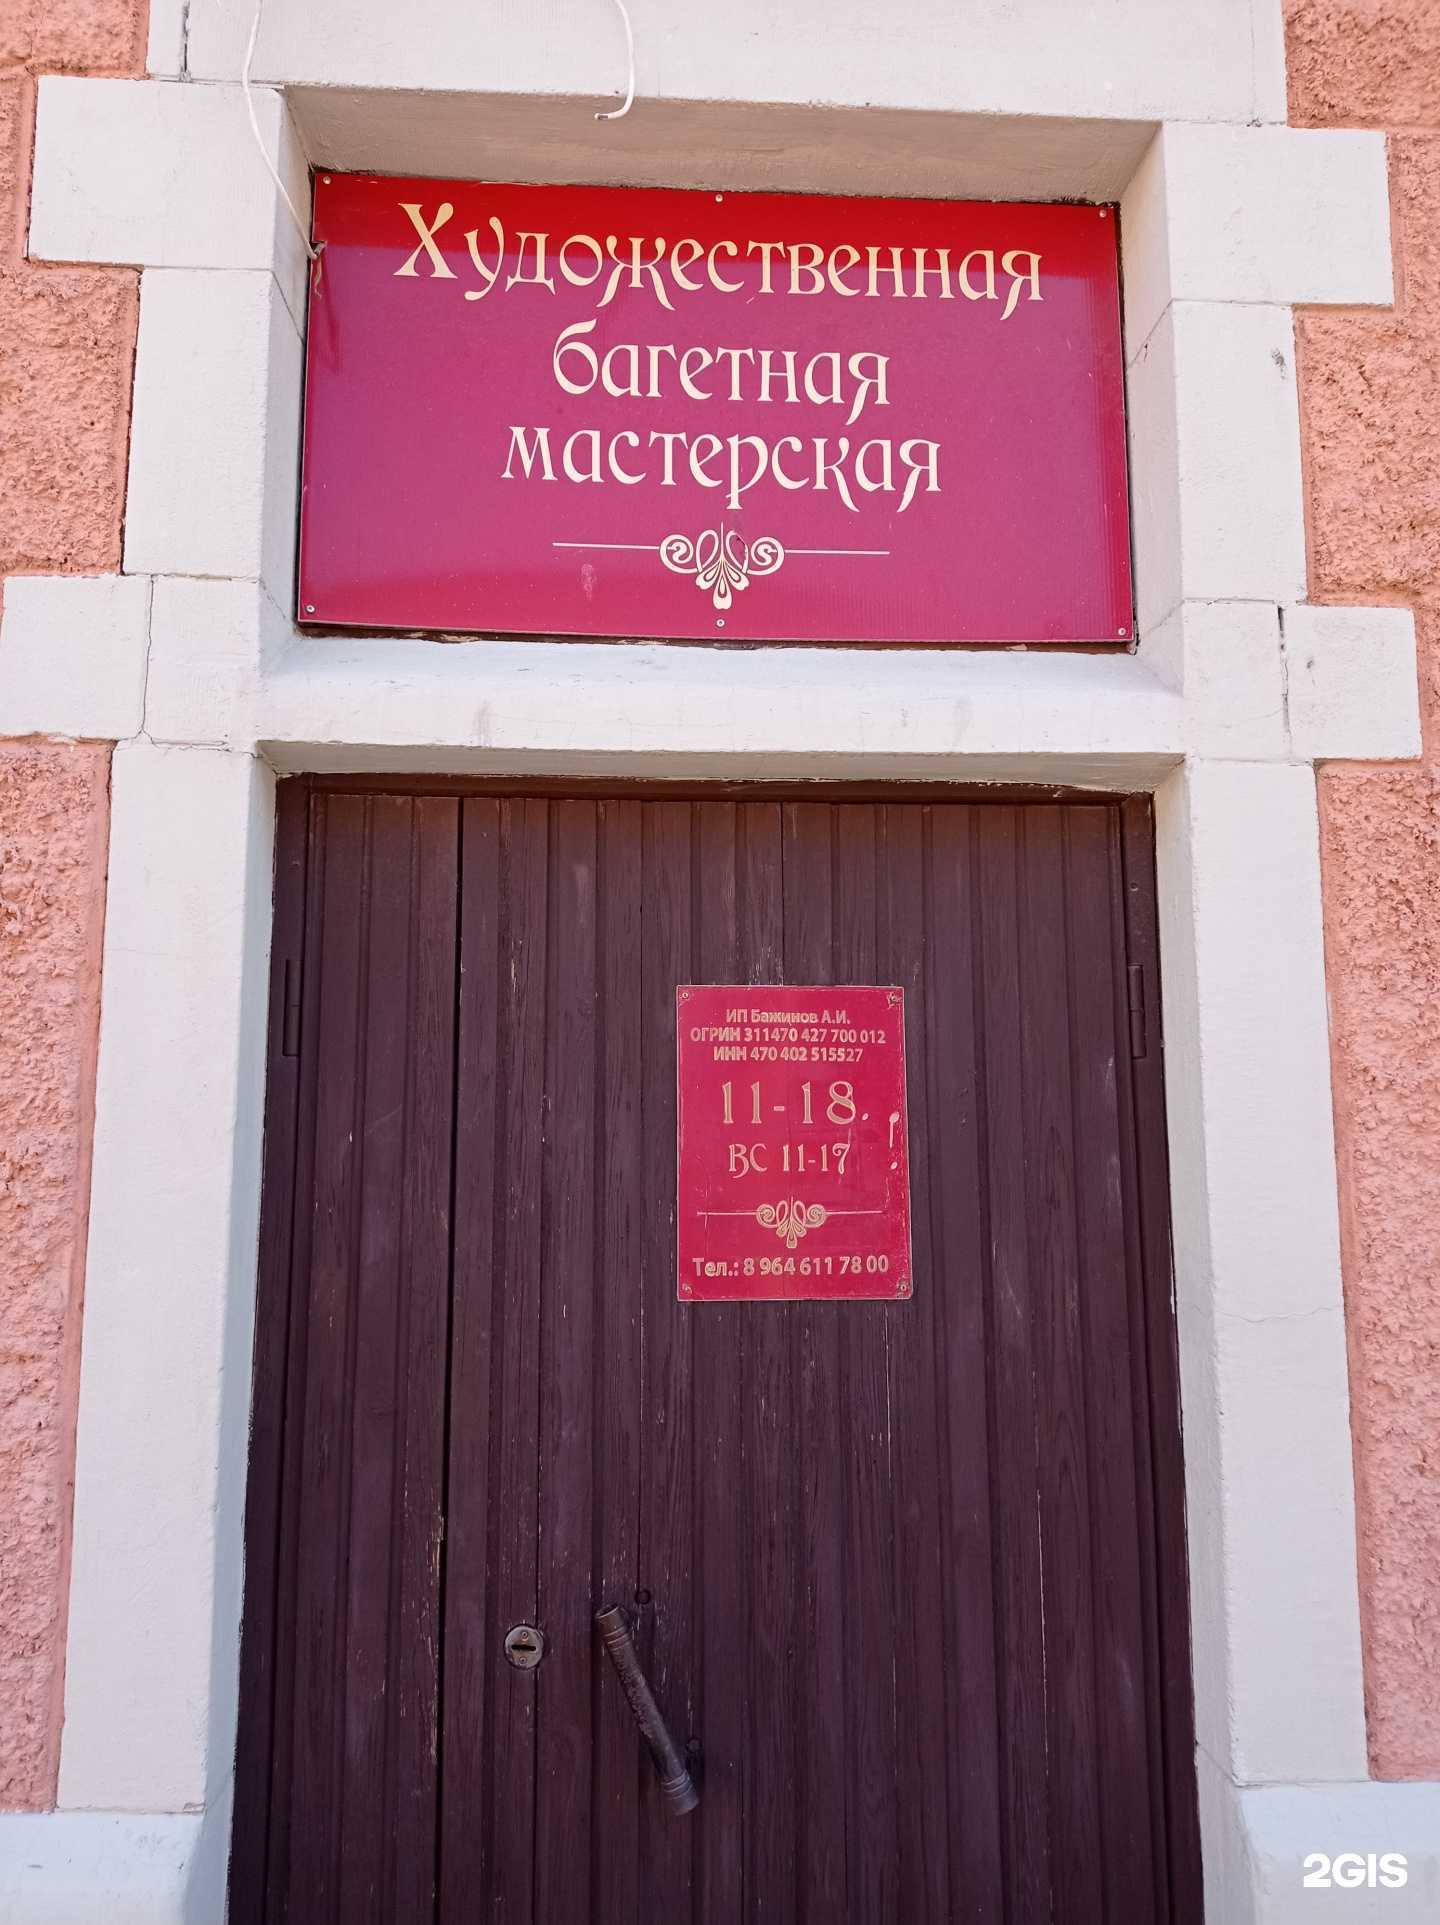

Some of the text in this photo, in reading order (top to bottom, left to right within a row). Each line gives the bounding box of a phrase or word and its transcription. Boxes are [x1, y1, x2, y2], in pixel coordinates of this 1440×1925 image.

[393, 201, 1046, 321] Художественная
[552, 318, 892, 426] багетная
[501, 424, 943, 513] мастерская
[726, 1008, 851, 1024] ИП Бажинов А.И.
[744, 1028, 799, 1042] 311470
[801, 1028, 828, 1042] 427
[831, 1028, 858, 1044] 700
[860, 1030, 887, 1044] 012
[713, 1046, 864, 1062] ИНН 470 402 515527
[728, 1143, 851, 1179] ВС 11-17
[692, 1254, 889, 1277] Тел.: 8 964 611 78 00
